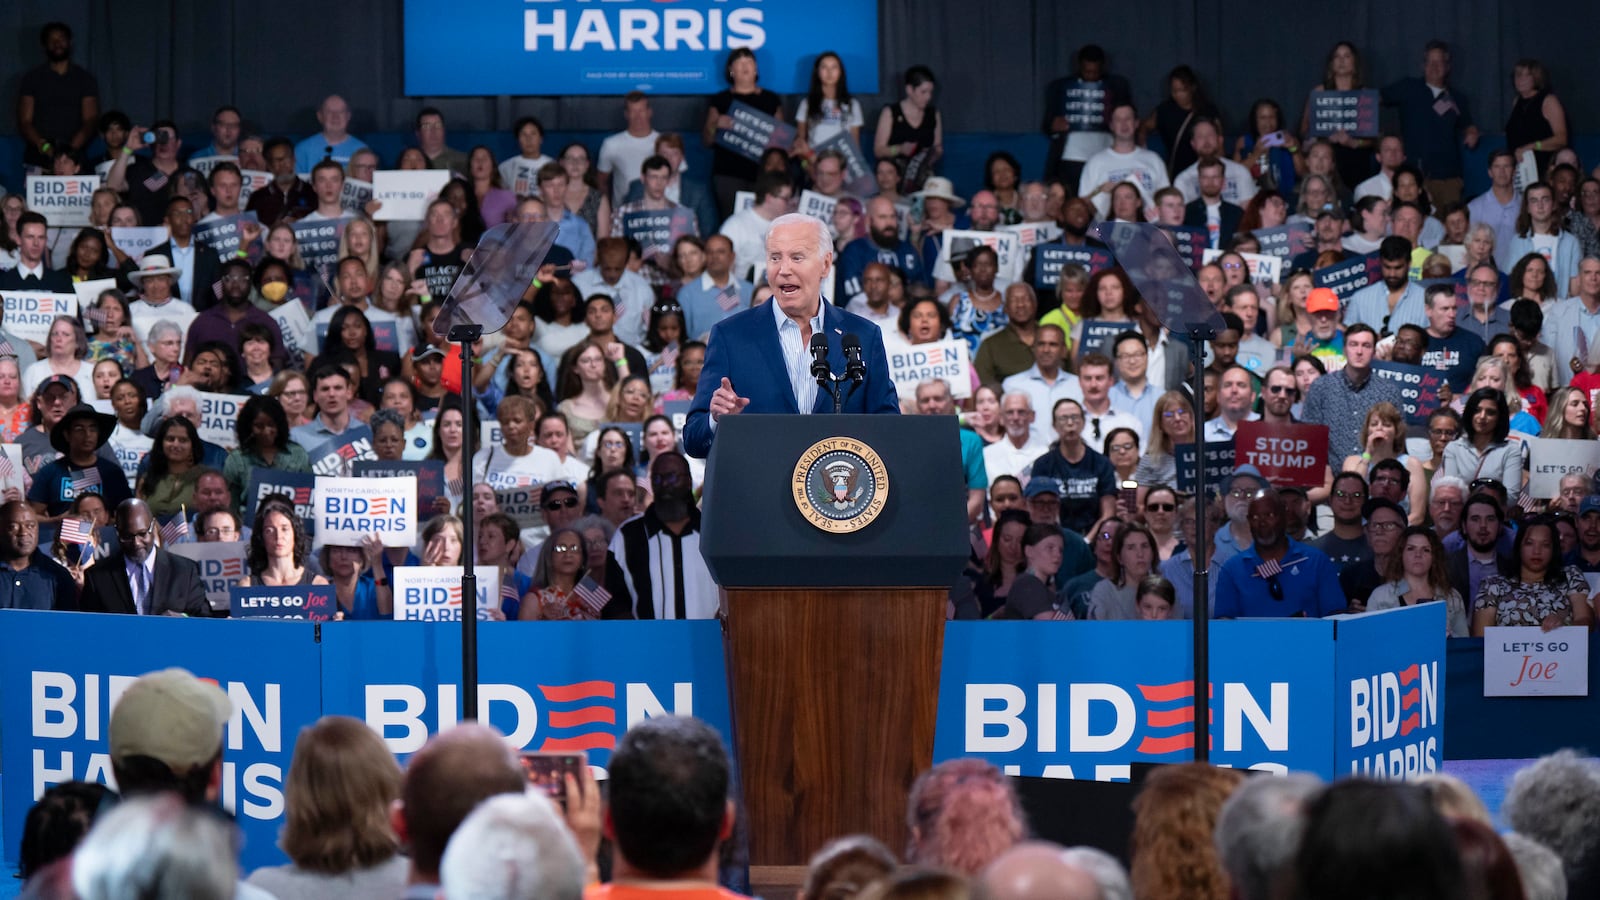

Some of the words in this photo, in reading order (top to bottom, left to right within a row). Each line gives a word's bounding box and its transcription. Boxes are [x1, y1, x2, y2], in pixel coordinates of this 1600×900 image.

[523, 8, 767, 51] HARRIS
[1316, 97, 1342, 106] LET'S
[1343, 97, 1358, 106] GO
[1316, 109, 1342, 118] LET'S
[1343, 109, 1358, 118] GO
[1316, 122, 1342, 131] LET'S
[1343, 122, 1358, 131] GO
[33, 181, 92, 195] BIDEN
[33, 195, 92, 207] HARRIS
[412, 191, 425, 200] GO
[138, 238, 153, 247] GO
[1043, 249, 1074, 261] LET'S
[1074, 251, 1092, 262] GO
[1349, 263, 1367, 275] GO
[1352, 276, 1369, 289] GO
[5, 297, 68, 312] BIDEN
[892, 346, 958, 369] BIDEN
[1403, 373, 1421, 384] GO
[1401, 388, 1419, 399] GO
[200, 399, 244, 416] BID
[839, 441, 849, 449] OF
[850, 443, 863, 452] THE
[1255, 436, 1309, 453] STOP
[796, 440, 838, 484] PRESIDENT
[1245, 451, 1317, 469] TRUMP
[864, 451, 886, 491] UNITED
[1537, 465, 1567, 474] LET'S
[1568, 465, 1585, 474] GO
[324, 487, 354, 495] NORTH
[354, 487, 396, 496] CAROLINA
[796, 488, 806, 501] THE
[325, 496, 406, 516] BIDEN
[808, 512, 833, 529] SEAL
[849, 498, 882, 529] STATES
[325, 516, 406, 532] HARRIS
[240, 596, 279, 608] LET'S
[281, 595, 304, 608] GO
[302, 592, 328, 610] Joe
[1502, 641, 1542, 652] LET'S
[1545, 641, 1567, 652] GO
[1508, 654, 1558, 686] Joe
[1350, 660, 1438, 748] BIDEN
[31, 670, 282, 753] BIN
[364, 680, 693, 755] BIDEN
[965, 679, 1289, 755] BIDEN
